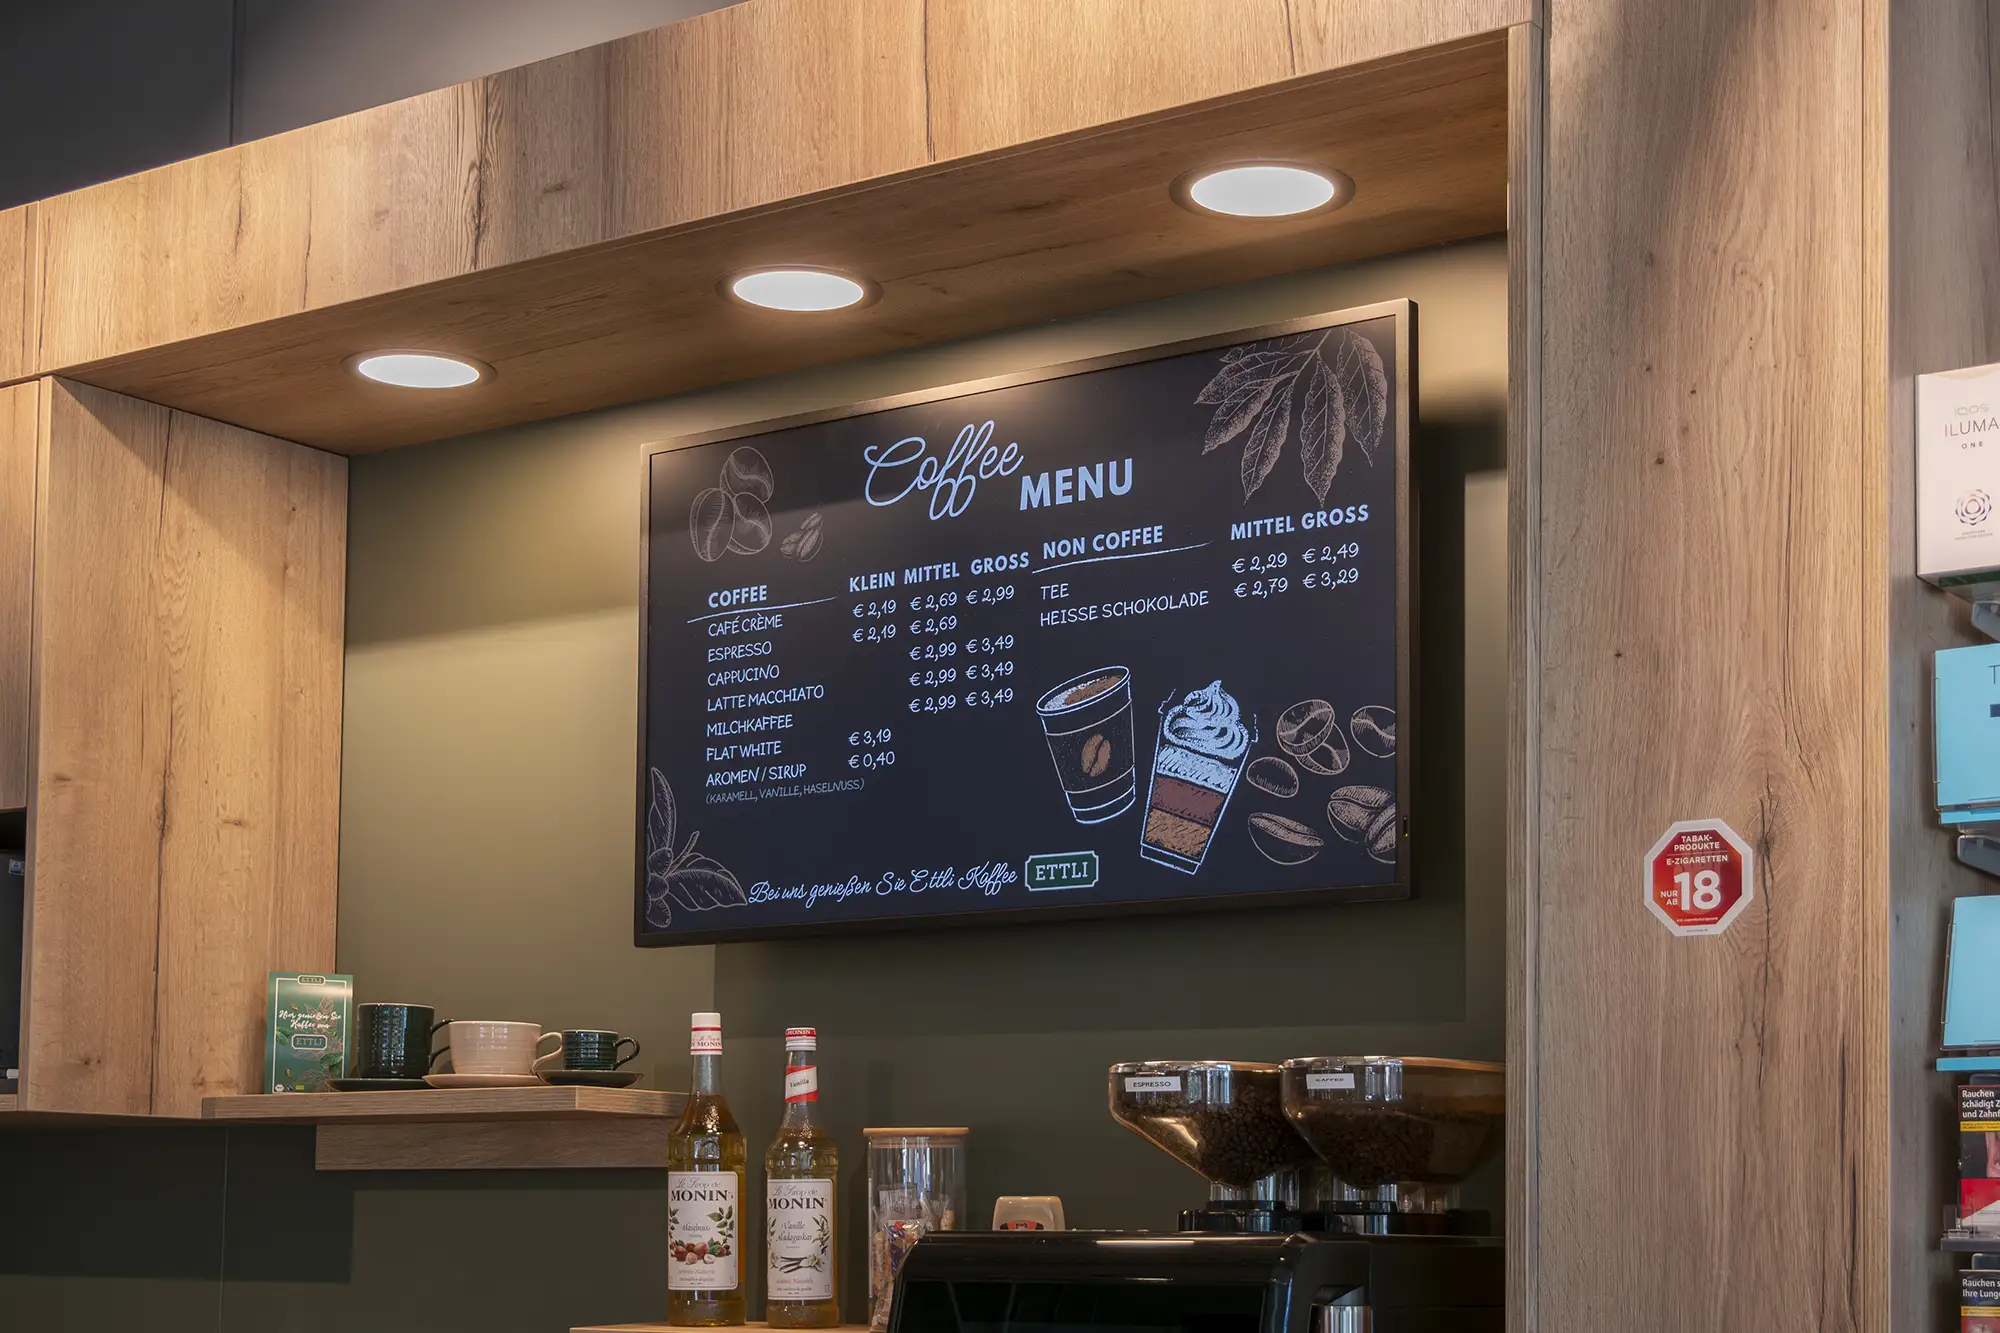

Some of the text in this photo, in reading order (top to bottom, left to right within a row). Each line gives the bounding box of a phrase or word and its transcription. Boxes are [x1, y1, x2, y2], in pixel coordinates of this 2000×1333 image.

[1944, 417, 1999, 437] ILUMA
[1962, 440, 1983, 450] ONE
[864, 420, 1024, 520] Coffee
[1020, 458, 1133, 511] MENU
[1230, 504, 1369, 540] MITTEL GROSS
[1042, 525, 1163, 560] NON COFFEE
[1232, 543, 1359, 575] € 2,29 € 2,49
[849, 552, 1030, 592] KLEIN MITTEL GROSS
[1040, 583, 1069, 600] TEE
[1234, 568, 1359, 600] € 2,79 € 3,29
[708, 585, 767, 608] COFFEE
[852, 585, 1014, 619] € 2,19 € 2,69 € 2,99
[1040, 590, 1209, 627] HEISSE SCHOKOLADE
[708, 613, 783, 636] CAFÉ CRÈME
[852, 616, 958, 644] € 2,19 € 2,69
[708, 641, 772, 662] ESPRESSO
[909, 634, 1014, 662] € 2,99 € 3,49
[708, 664, 780, 686] CAPPUCINO
[909, 661, 1014, 688] € 2,99 € 3,49
[707, 684, 824, 712] LATTE MACCHIATO
[909, 688, 1014, 714] € 2,99 € 3,49
[707, 714, 794, 737] MILCHKAFFEE
[848, 728, 892, 748] € 3,19
[706, 740, 782, 762] FLAT WHITE
[848, 751, 896, 770] € 0,40
[706, 764, 806, 787] AROMEN / SIRUP
[706, 778, 864, 804] (KARAMELL, VANILLE, HASELNUSS)
[1674, 842, 1720, 852] PRODUKTE
[1681, 834, 1712, 843] TABAK-
[1666, 854, 1728, 866] E-ZIGARETTEN
[1036, 862, 1088, 881] ETTLI
[748, 861, 1018, 908] Bei uns genießen Sie Ettli Kaffee
[1660, 890, 1678, 898] NUR
[1673, 869, 1720, 910] 18
[279, 1010, 296, 1020] Hier
[330, 1011, 342, 1020] Sie
[290, 1020, 316, 1030] Kaffee
[296, 1038, 322, 1046] ETTLI
[1132, 1080, 1172, 1088] ESPRESSO
[1962, 1090, 1994, 1098] Rauchen
[1962, 1100, 1994, 1110] schädigt
[1962, 1110, 1977, 1118] und
[672, 1190, 728, 1202] MONIN
[769, 1198, 824, 1210] MONIN
[1962, 1278, 1996, 1287] Rauchen
[1962, 1289, 1978, 1297] Ihre
